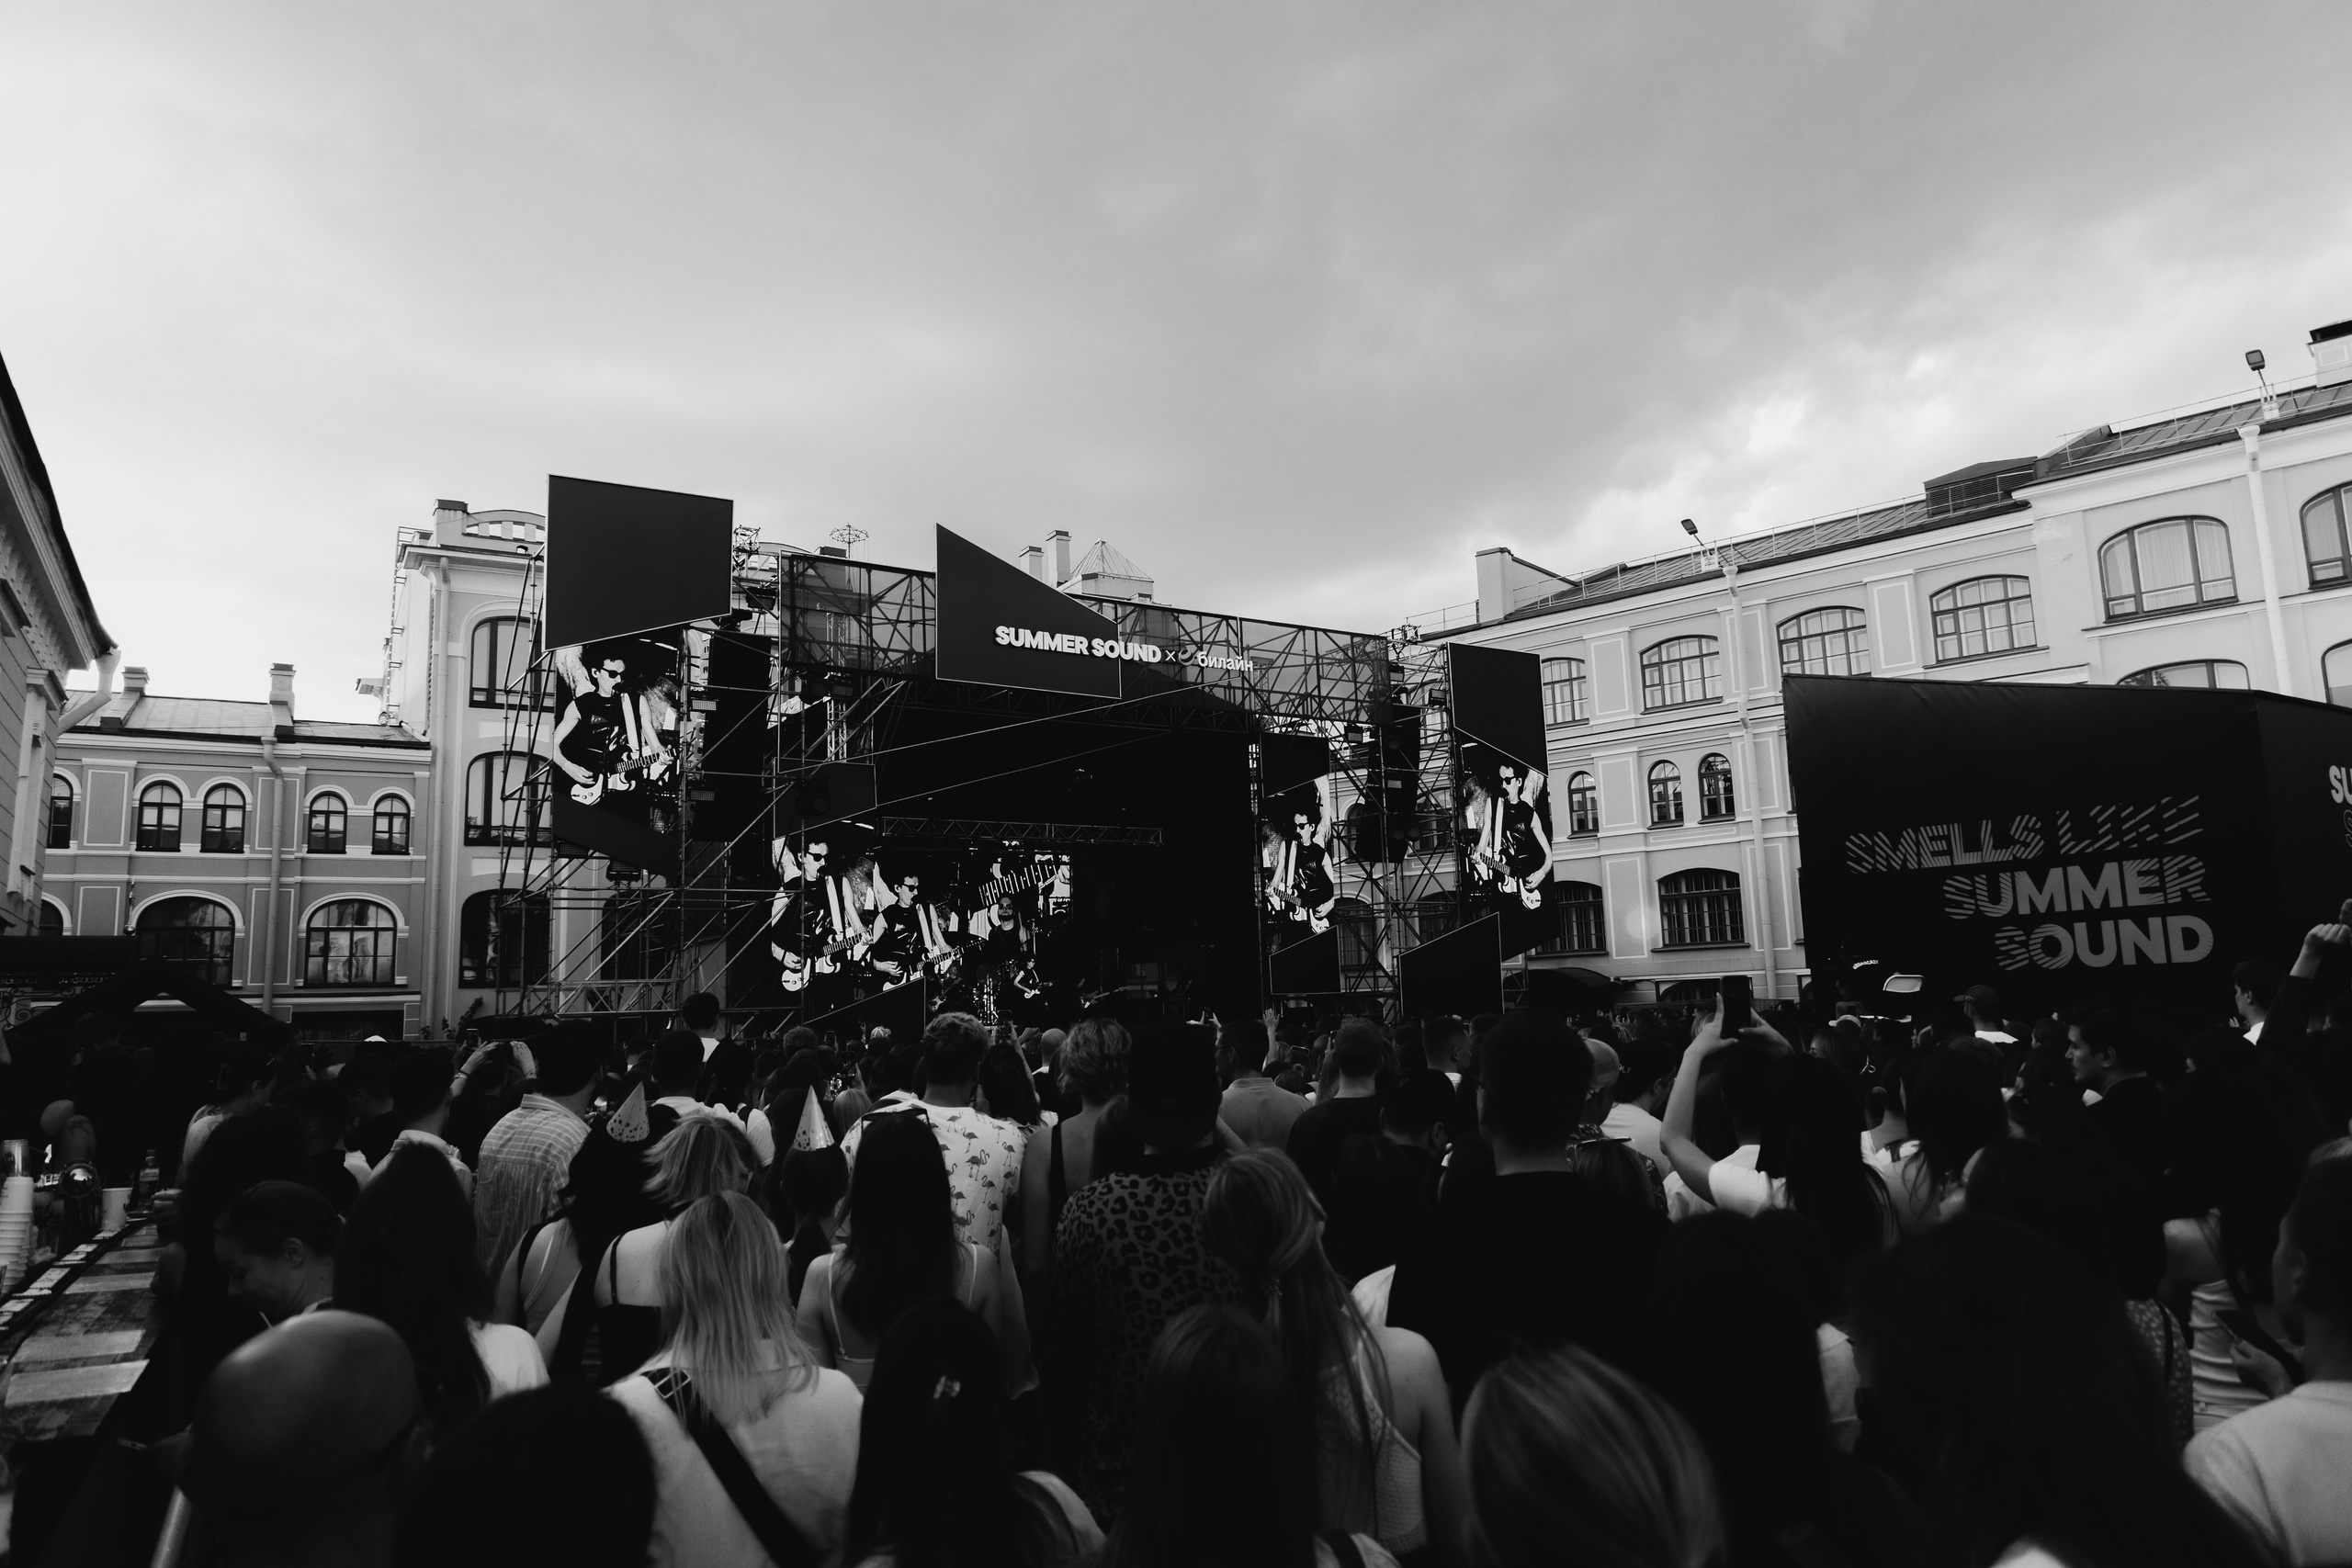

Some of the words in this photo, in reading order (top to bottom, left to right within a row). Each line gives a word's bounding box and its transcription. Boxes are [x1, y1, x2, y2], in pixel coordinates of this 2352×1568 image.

[995, 626, 1090, 656] SUMMER
[1091, 637, 1162, 663] SOUND
[1196, 650, 1254, 672] билайн
[1845, 813, 2045, 874] SMELLS
[2056, 794, 2204, 855] LIKE
[1942, 853, 2212, 920] SUMMER
[1994, 915, 2215, 972] SOUND
